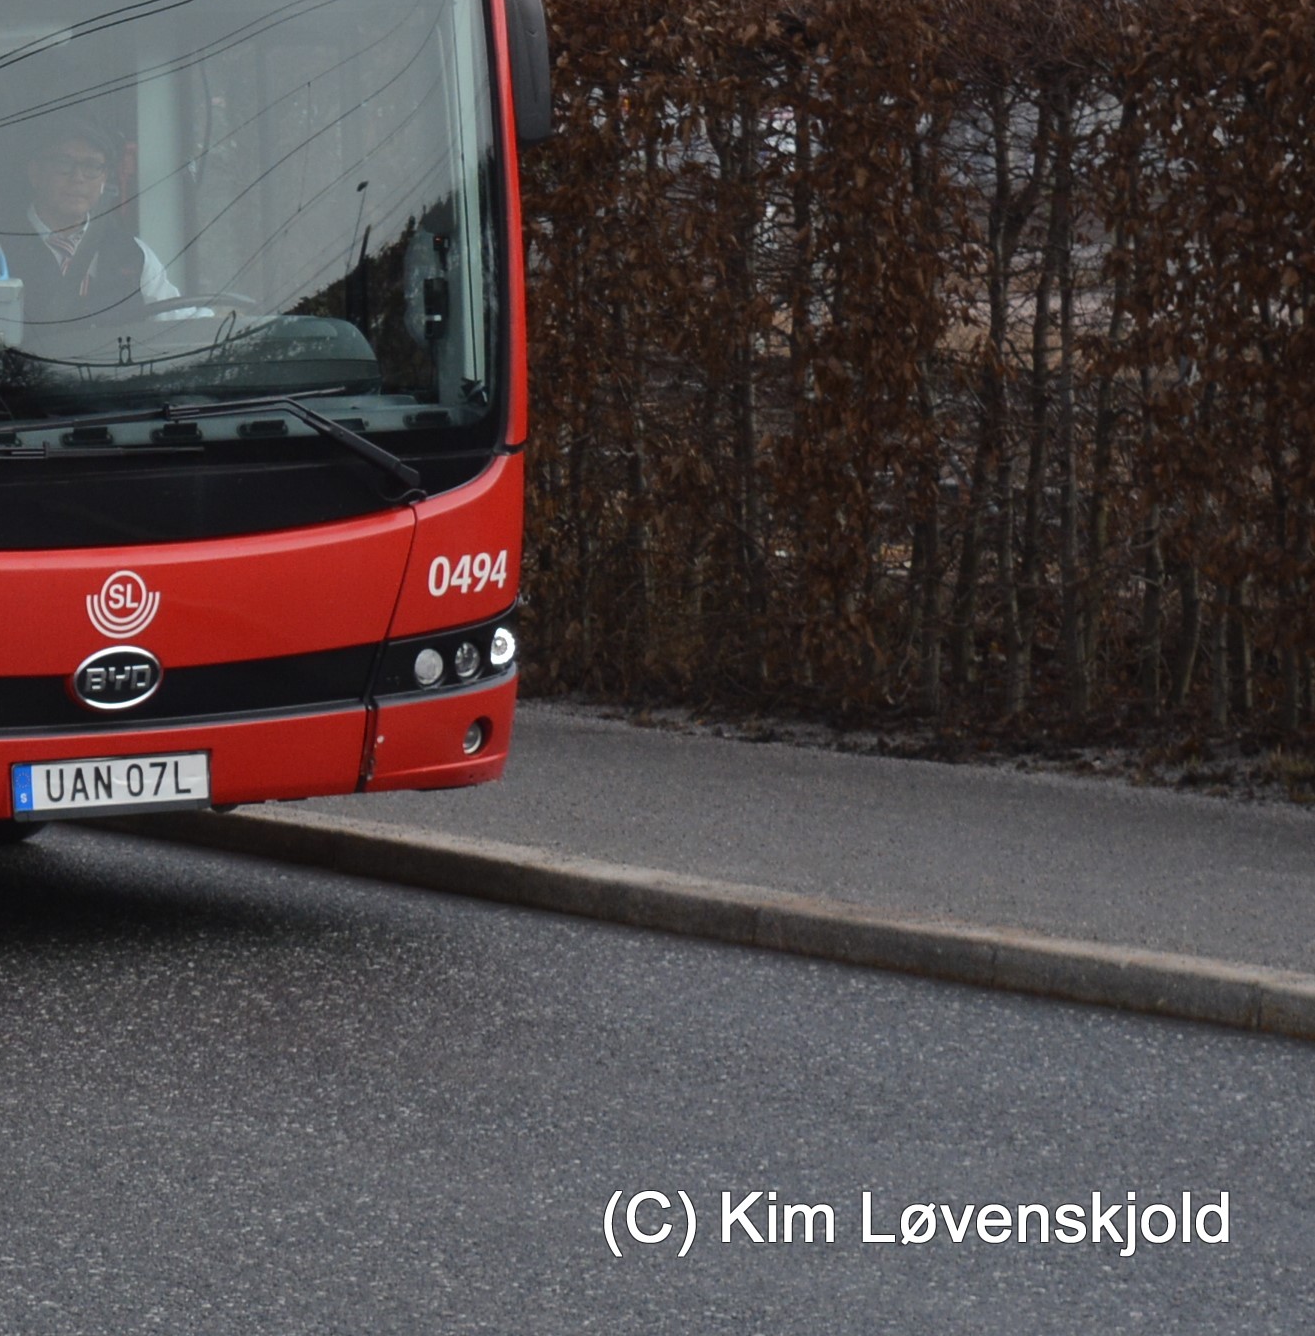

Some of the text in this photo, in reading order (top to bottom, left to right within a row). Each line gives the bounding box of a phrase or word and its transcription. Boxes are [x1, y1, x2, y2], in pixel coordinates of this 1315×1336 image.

[428, 549, 507, 597] 0494
[108, 583, 139, 610] SL
[85, 664, 152, 692] BYD
[45, 760, 192, 803] UAN 07L
